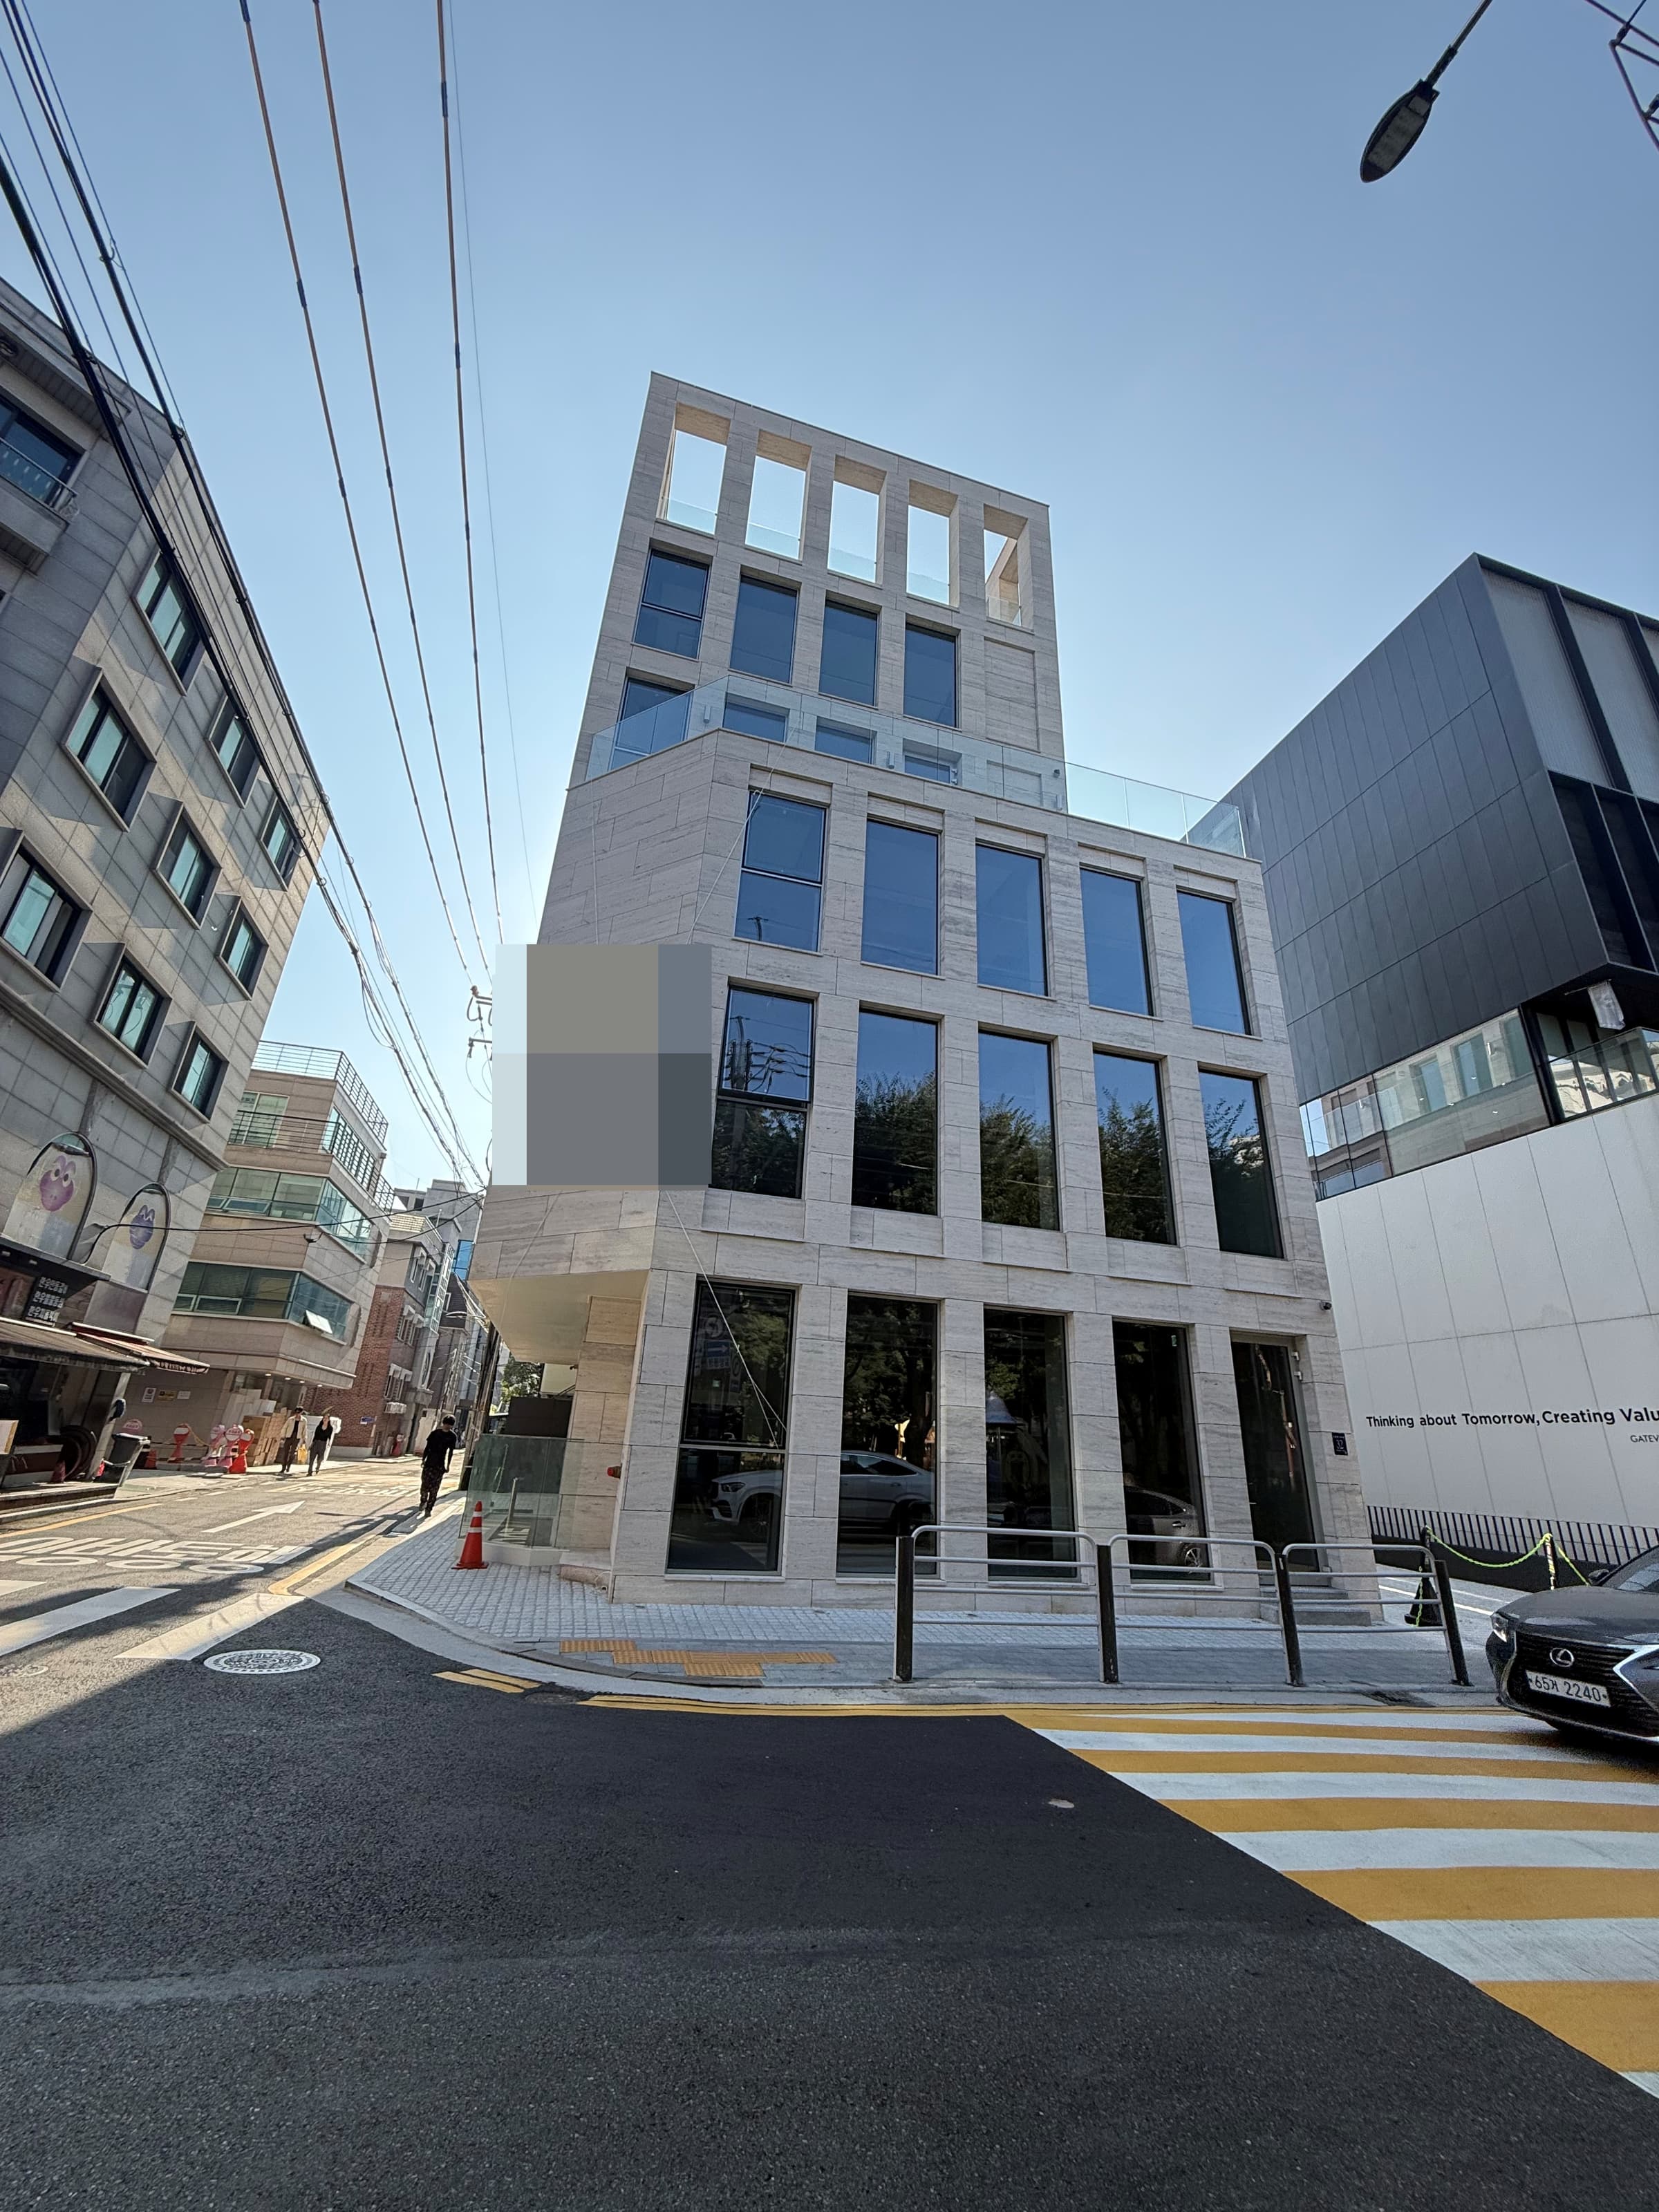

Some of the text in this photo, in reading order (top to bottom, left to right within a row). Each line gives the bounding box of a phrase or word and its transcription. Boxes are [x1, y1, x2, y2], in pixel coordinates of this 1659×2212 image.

[1366, 1407, 1659, 1428] Thinking about Tomorrow, Creating Valu
[1564, 1680, 1601, 1702] 2240
